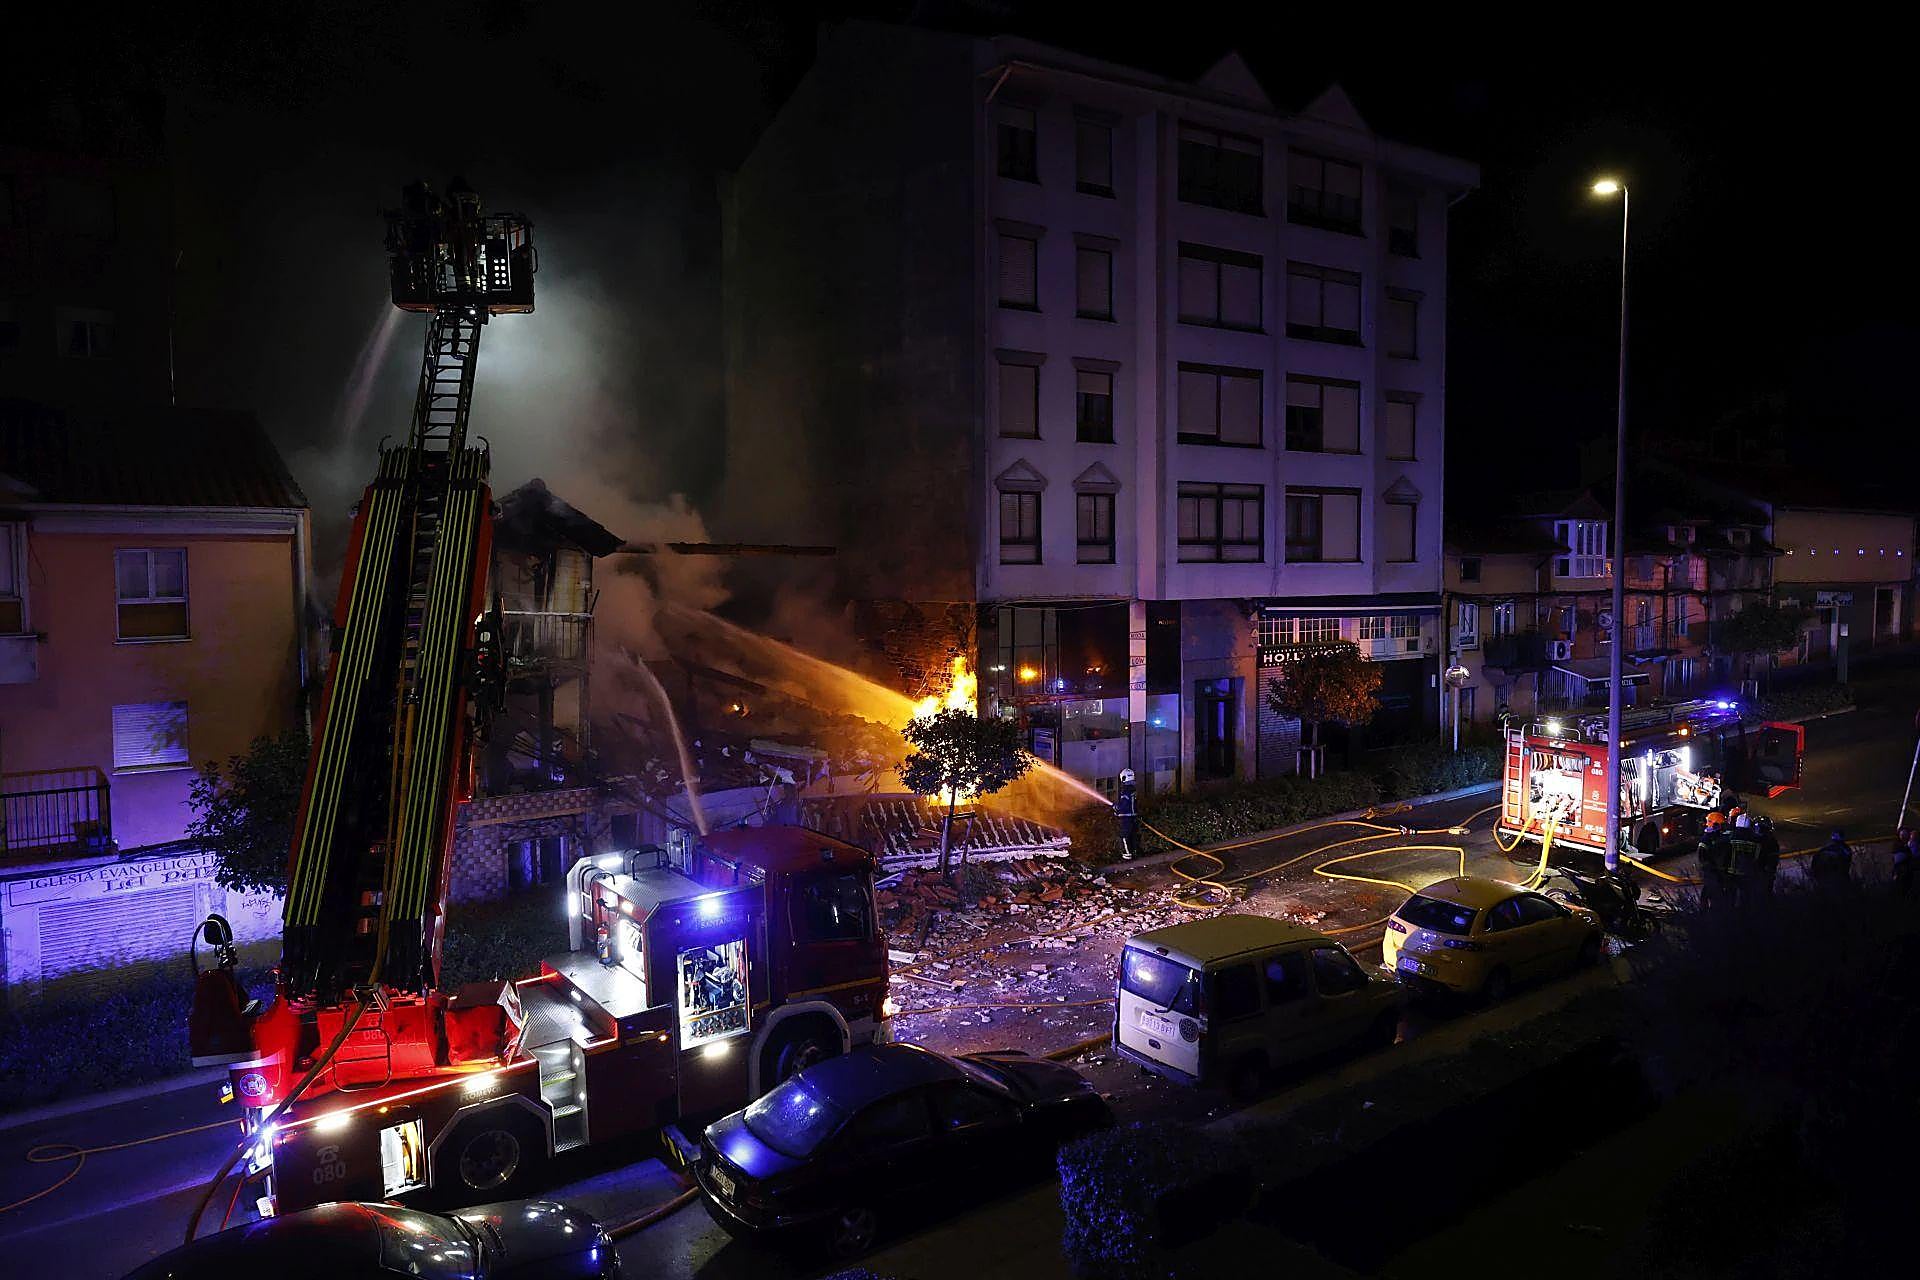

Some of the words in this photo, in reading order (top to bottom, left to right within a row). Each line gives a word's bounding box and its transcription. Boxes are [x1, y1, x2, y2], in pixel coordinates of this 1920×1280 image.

[30, 871, 94, 889] IGLESIA
[100, 857, 197, 879] EVANGELICA
[312, 1160, 346, 1184] 080
